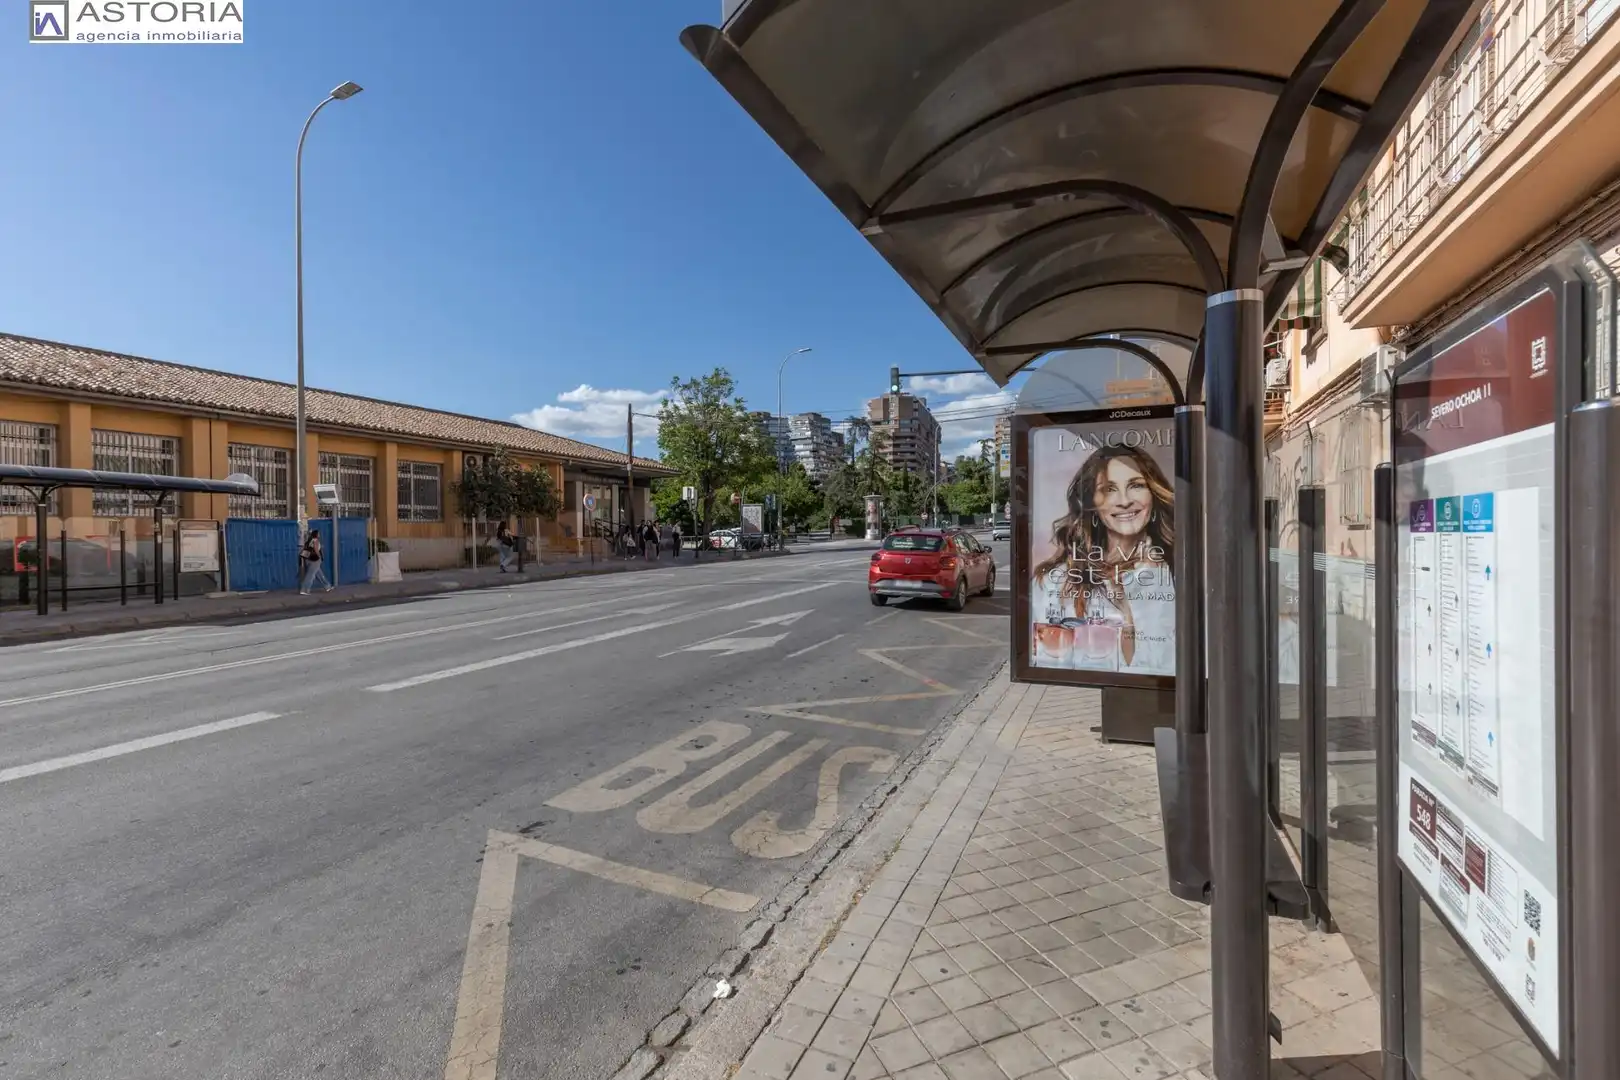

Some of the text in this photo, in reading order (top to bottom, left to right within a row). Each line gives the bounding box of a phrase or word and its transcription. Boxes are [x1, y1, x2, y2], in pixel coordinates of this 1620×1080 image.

[1109, 410, 1151, 419] JCDecaux
[1431, 399, 1454, 419] SEVERO
[1455, 387, 1482, 409] OCHOA
[1072, 541, 1165, 562] La vie
[1048, 564, 1172, 587] est bell
[1048, 589, 1079, 599] FELIZ
[1107, 590, 1124, 600] DE
[1127, 591, 1144, 600] LA
[1147, 592, 1175, 601] MAD
[543, 719, 901, 859] BUS
[1416, 803, 1431, 830] 548
